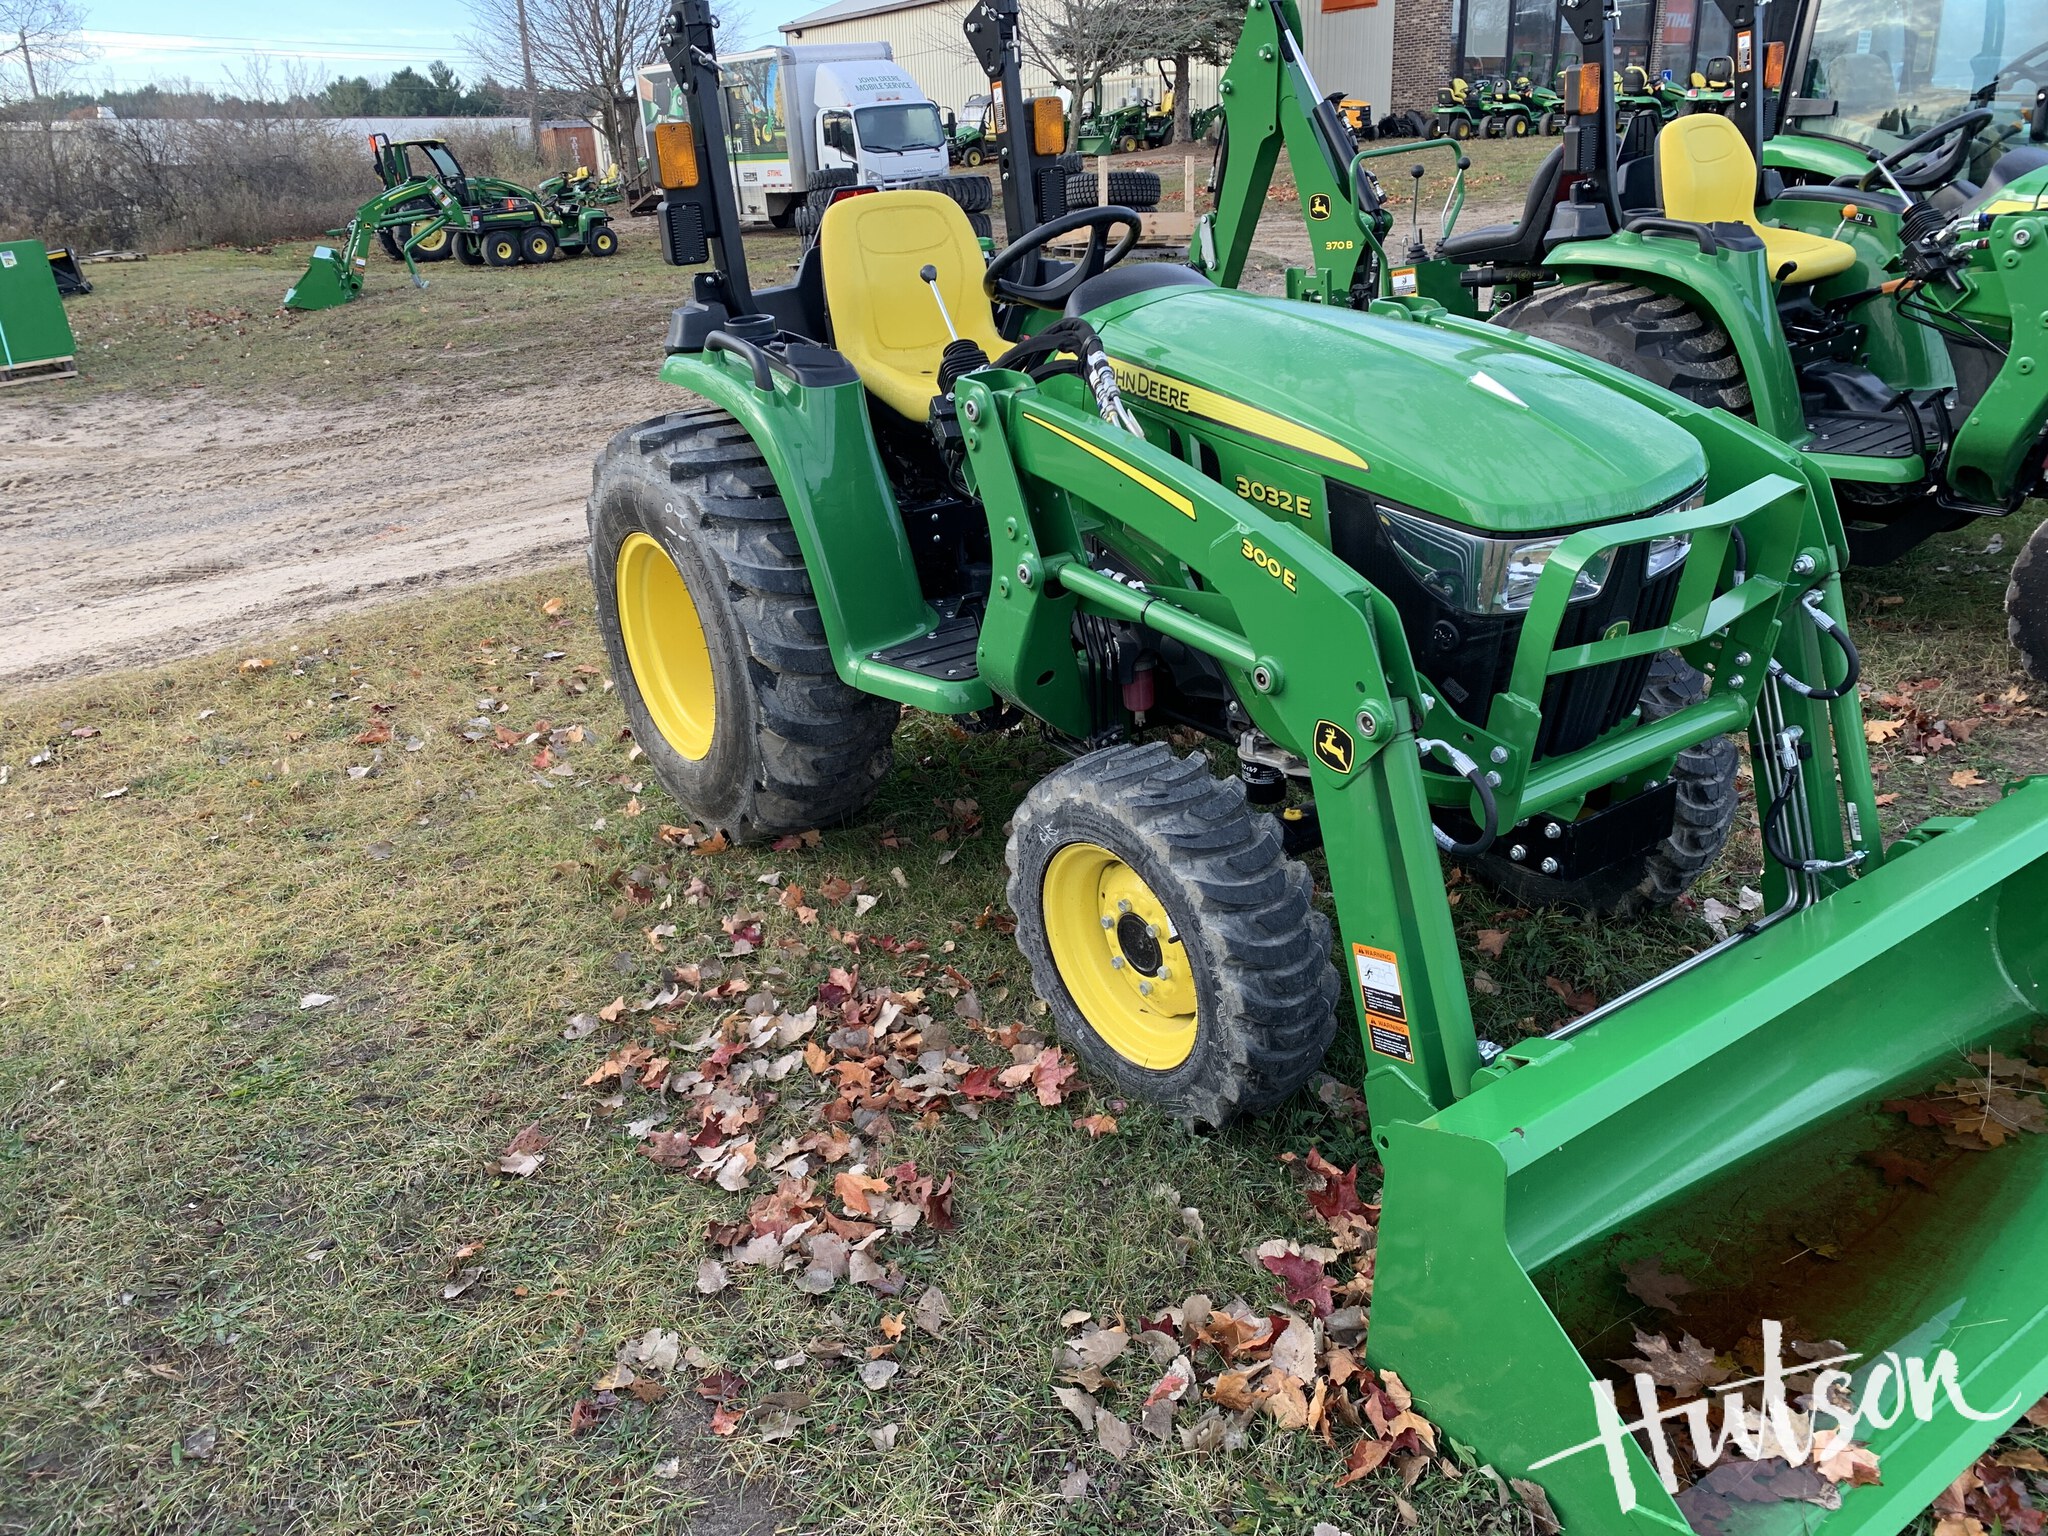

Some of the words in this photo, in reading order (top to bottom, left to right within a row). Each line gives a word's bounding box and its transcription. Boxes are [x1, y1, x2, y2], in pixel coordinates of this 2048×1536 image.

[1665, 12, 1692, 28] TIHL
[855, 83, 885, 91] MOBILE
[1137, 372, 1190, 410] DEERE
[1364, 949, 1392, 960] WARNING
[1379, 1021, 1405, 1033] WARNING
